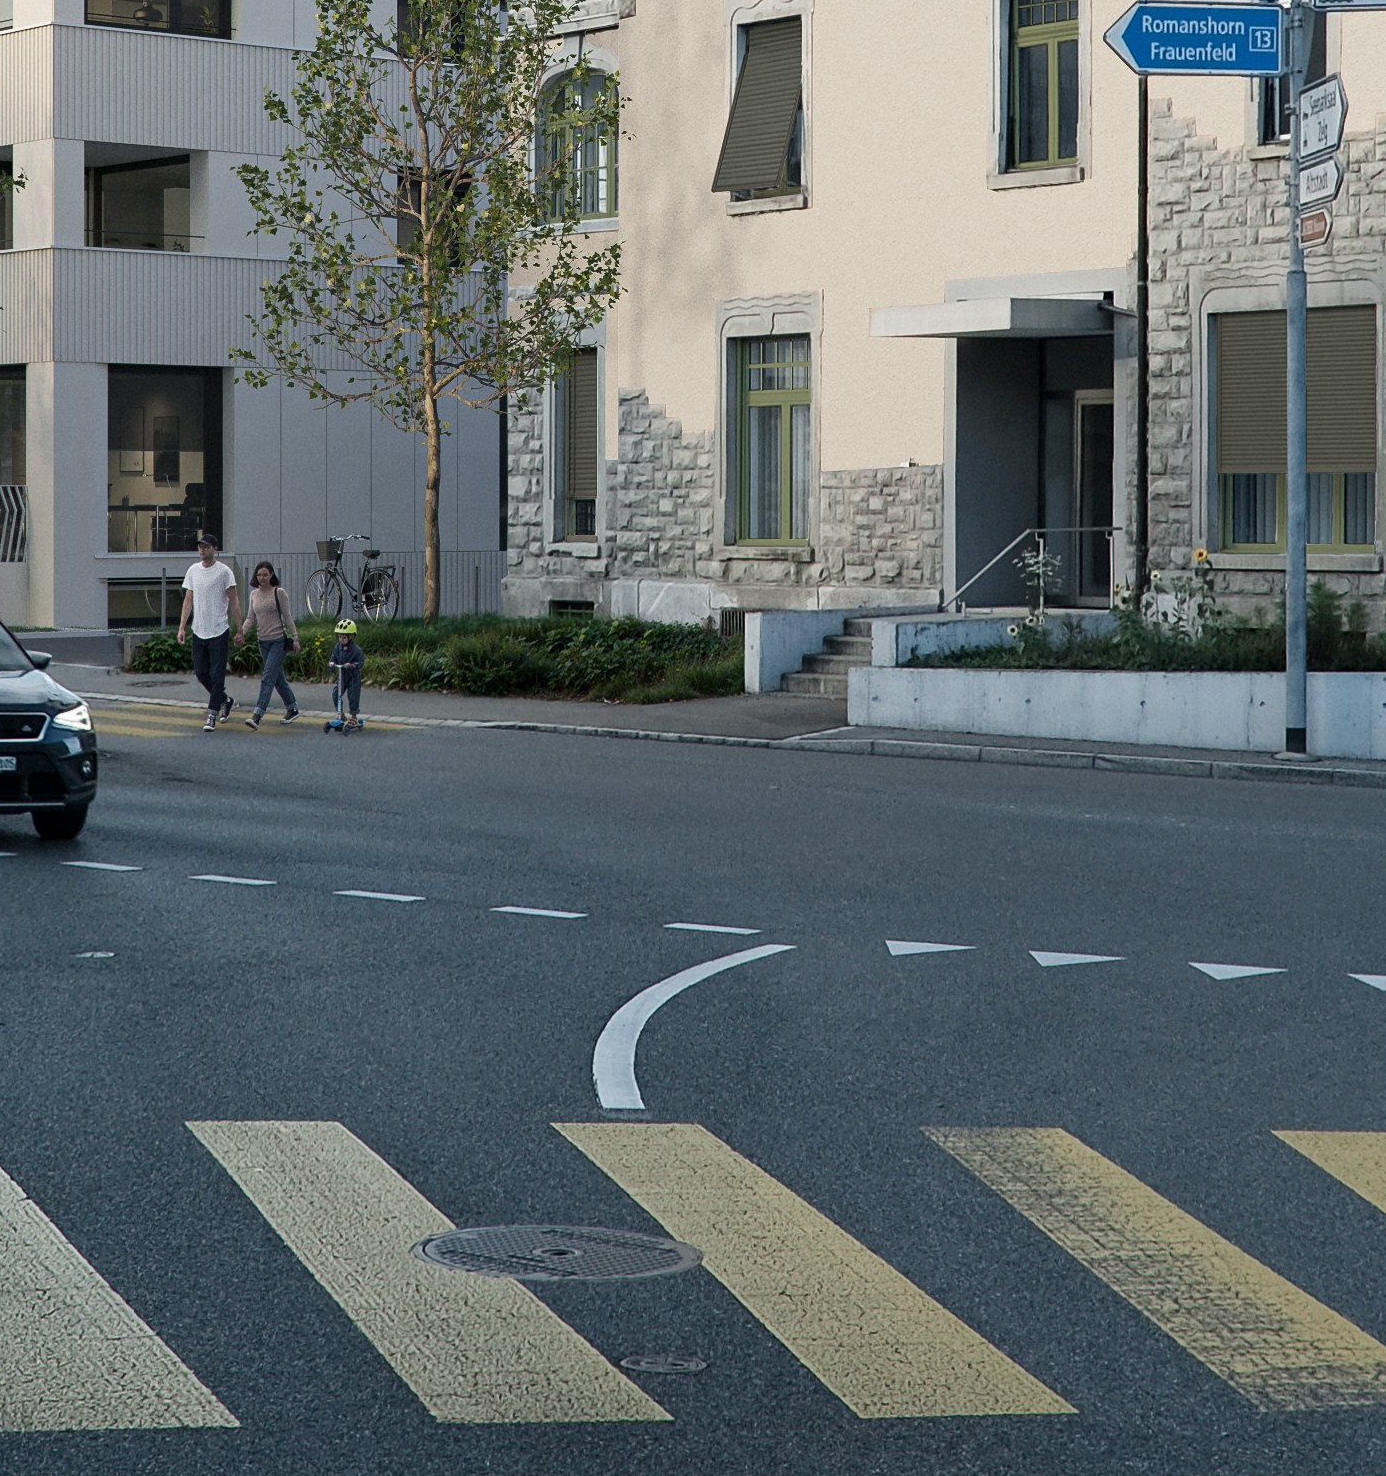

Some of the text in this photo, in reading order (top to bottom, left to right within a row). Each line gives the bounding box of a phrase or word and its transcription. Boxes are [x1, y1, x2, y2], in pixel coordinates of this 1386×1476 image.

[1142, 15, 1245, 35] Romanshorn
[1254, 31, 1271, 48] 13
[1150, 41, 1236, 61] Frauenfeld
[1305, 166, 1329, 196] Altstadt
